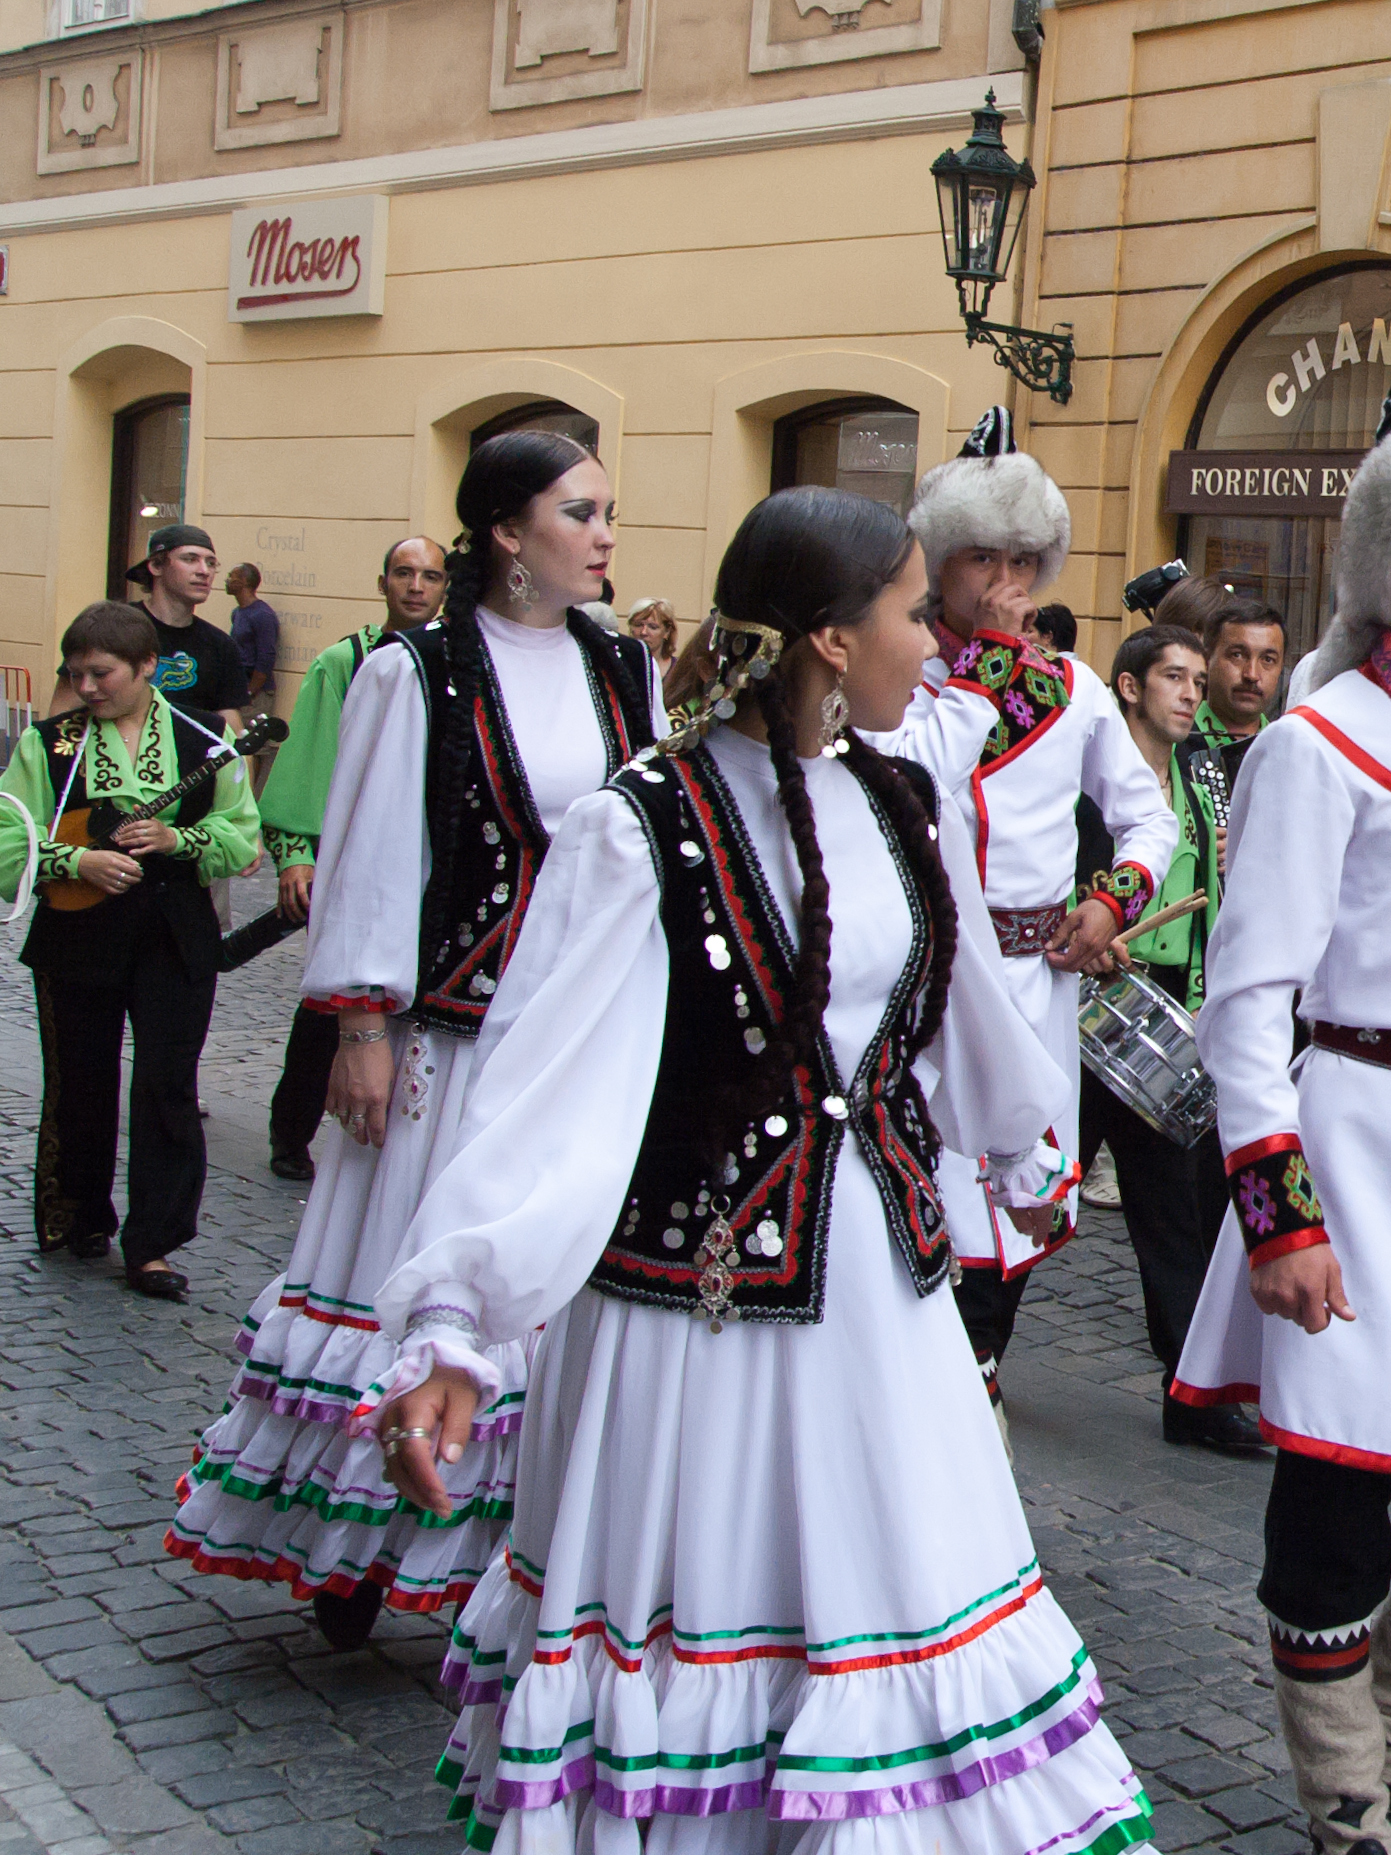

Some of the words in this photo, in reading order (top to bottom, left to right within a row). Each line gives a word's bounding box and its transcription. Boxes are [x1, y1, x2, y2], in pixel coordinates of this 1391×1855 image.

[246, 216, 361, 288] Moser
[1190, 468, 1312, 497] FOREIGN
[256, 526, 306, 556] Crystal
